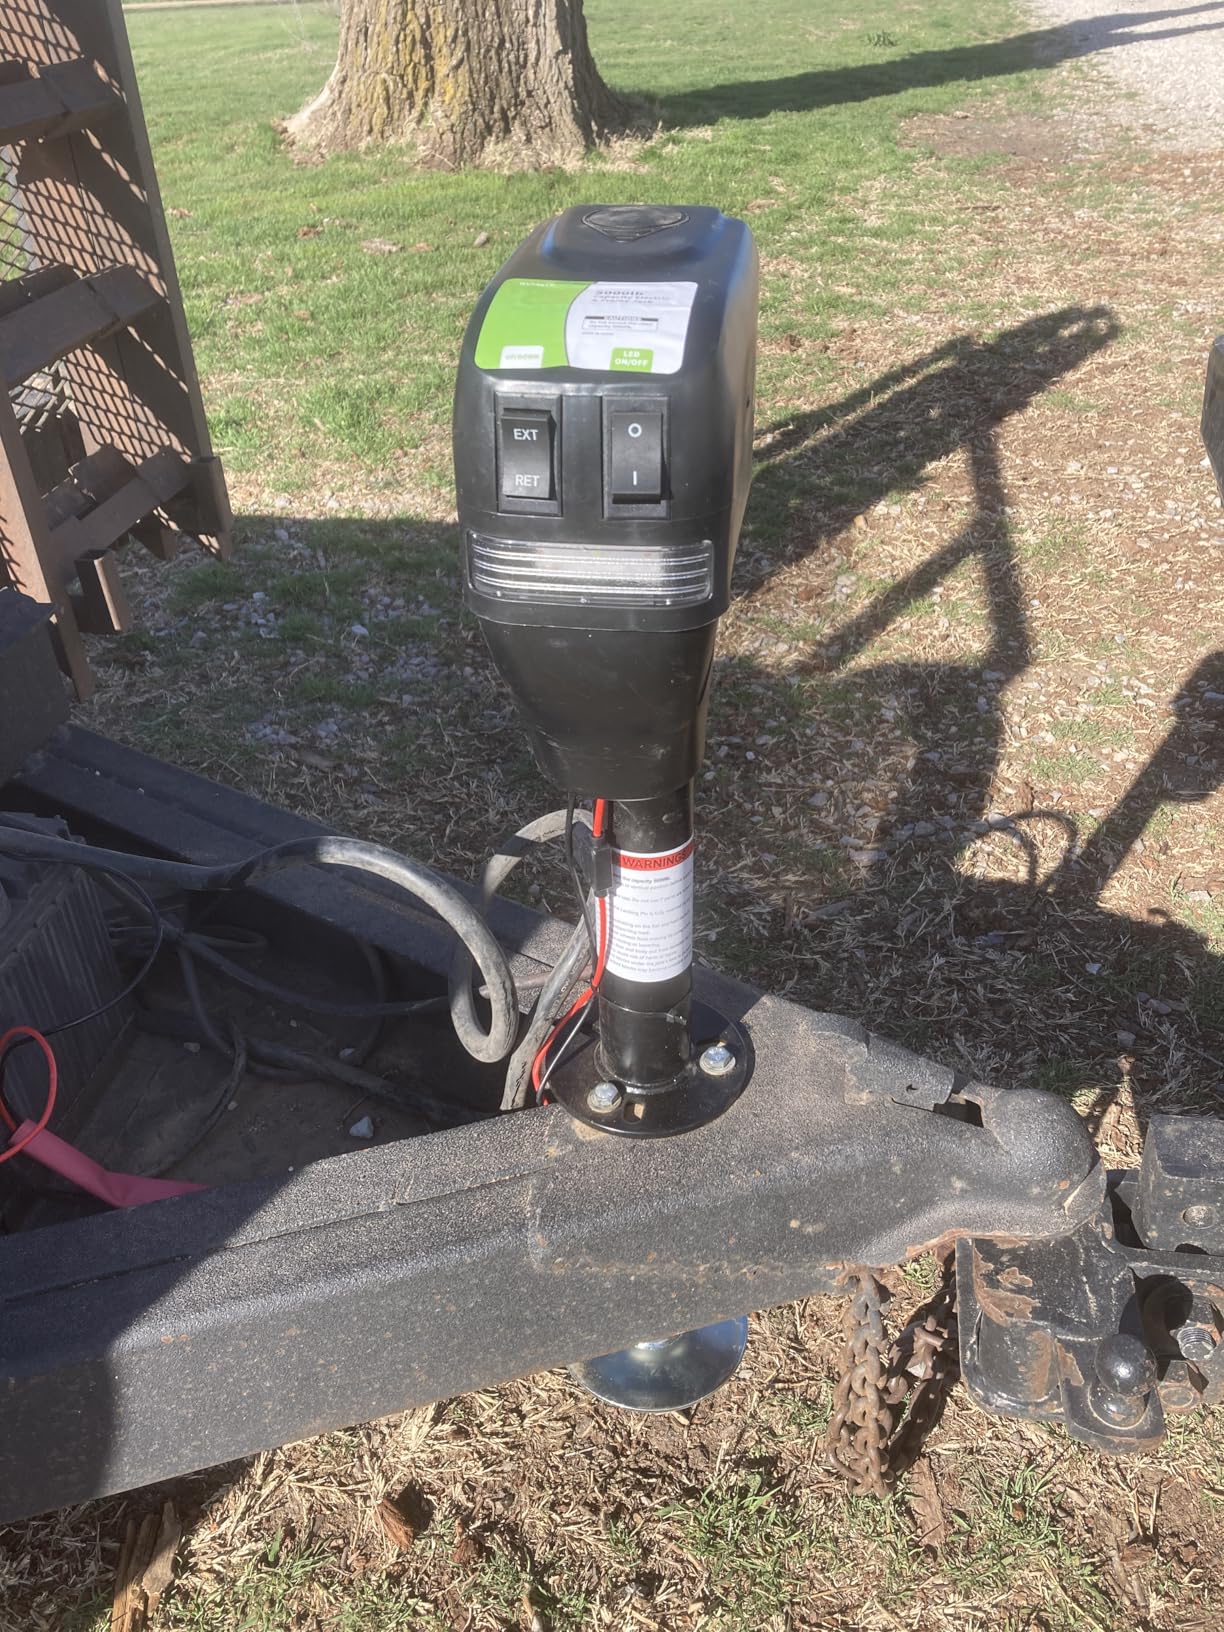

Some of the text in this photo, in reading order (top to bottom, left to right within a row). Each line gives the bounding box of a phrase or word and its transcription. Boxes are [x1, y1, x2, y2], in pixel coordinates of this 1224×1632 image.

[623, 350, 641, 358] LED
[614, 358, 649, 367] ON/OFF
[513, 428, 539, 441] EXT
[515, 474, 541, 487] RET
